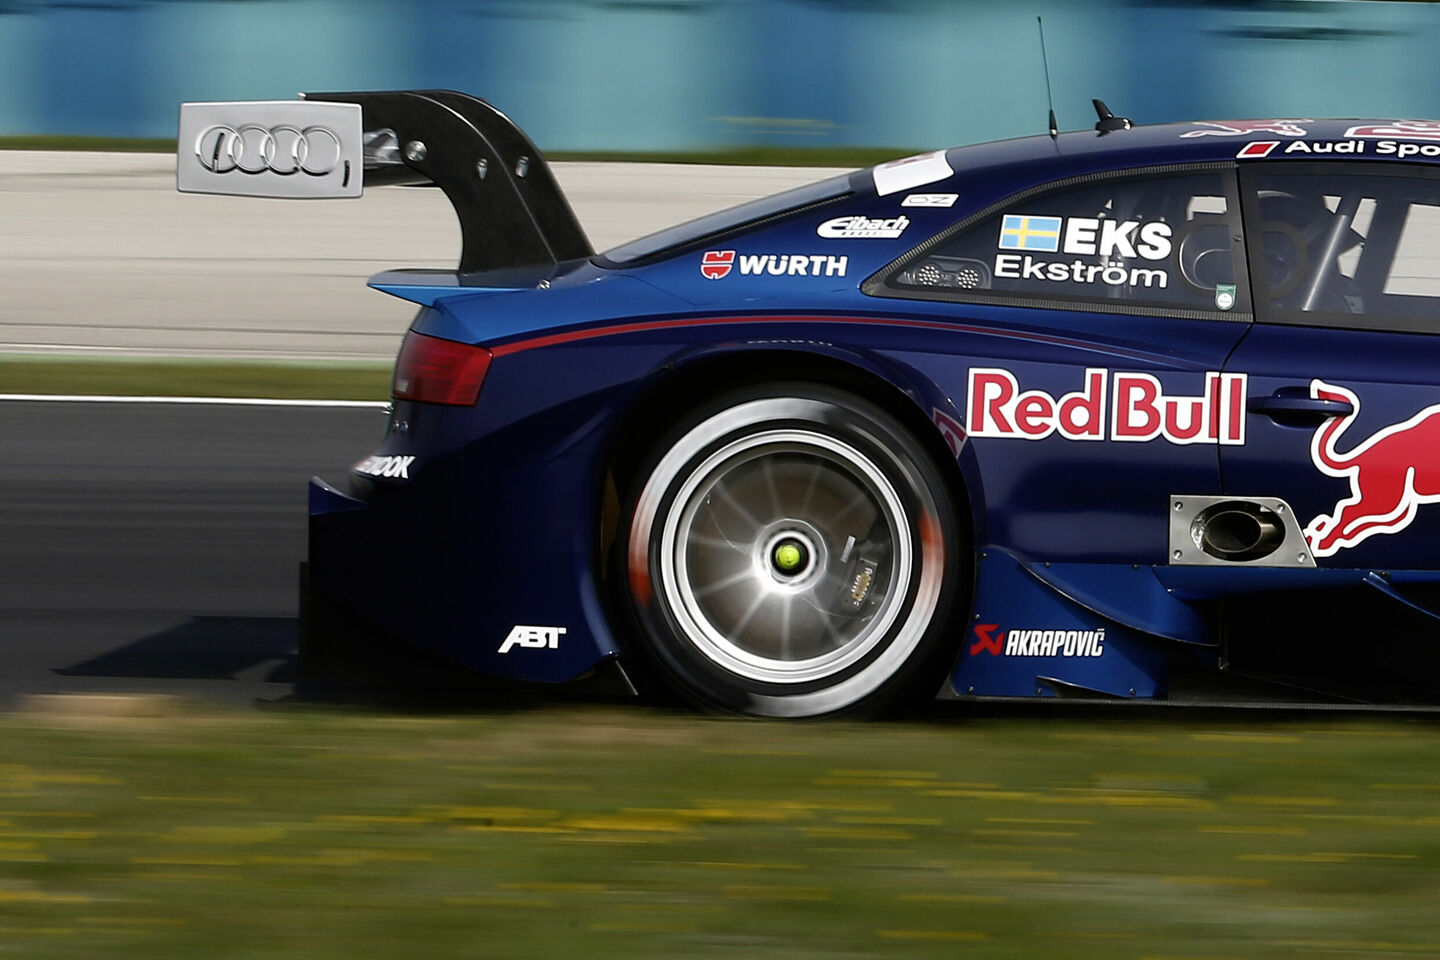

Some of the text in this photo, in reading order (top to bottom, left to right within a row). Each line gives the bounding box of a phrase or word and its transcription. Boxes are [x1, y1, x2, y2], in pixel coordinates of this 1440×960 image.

[1284, 140, 1365, 154] Audi
[817, 215, 910, 238] Eibach
[1063, 217, 1173, 261] EKS
[994, 254, 1169, 289] Ekström
[970, 371, 1245, 442] Red Bull
[497, 625, 567, 653] ABT
